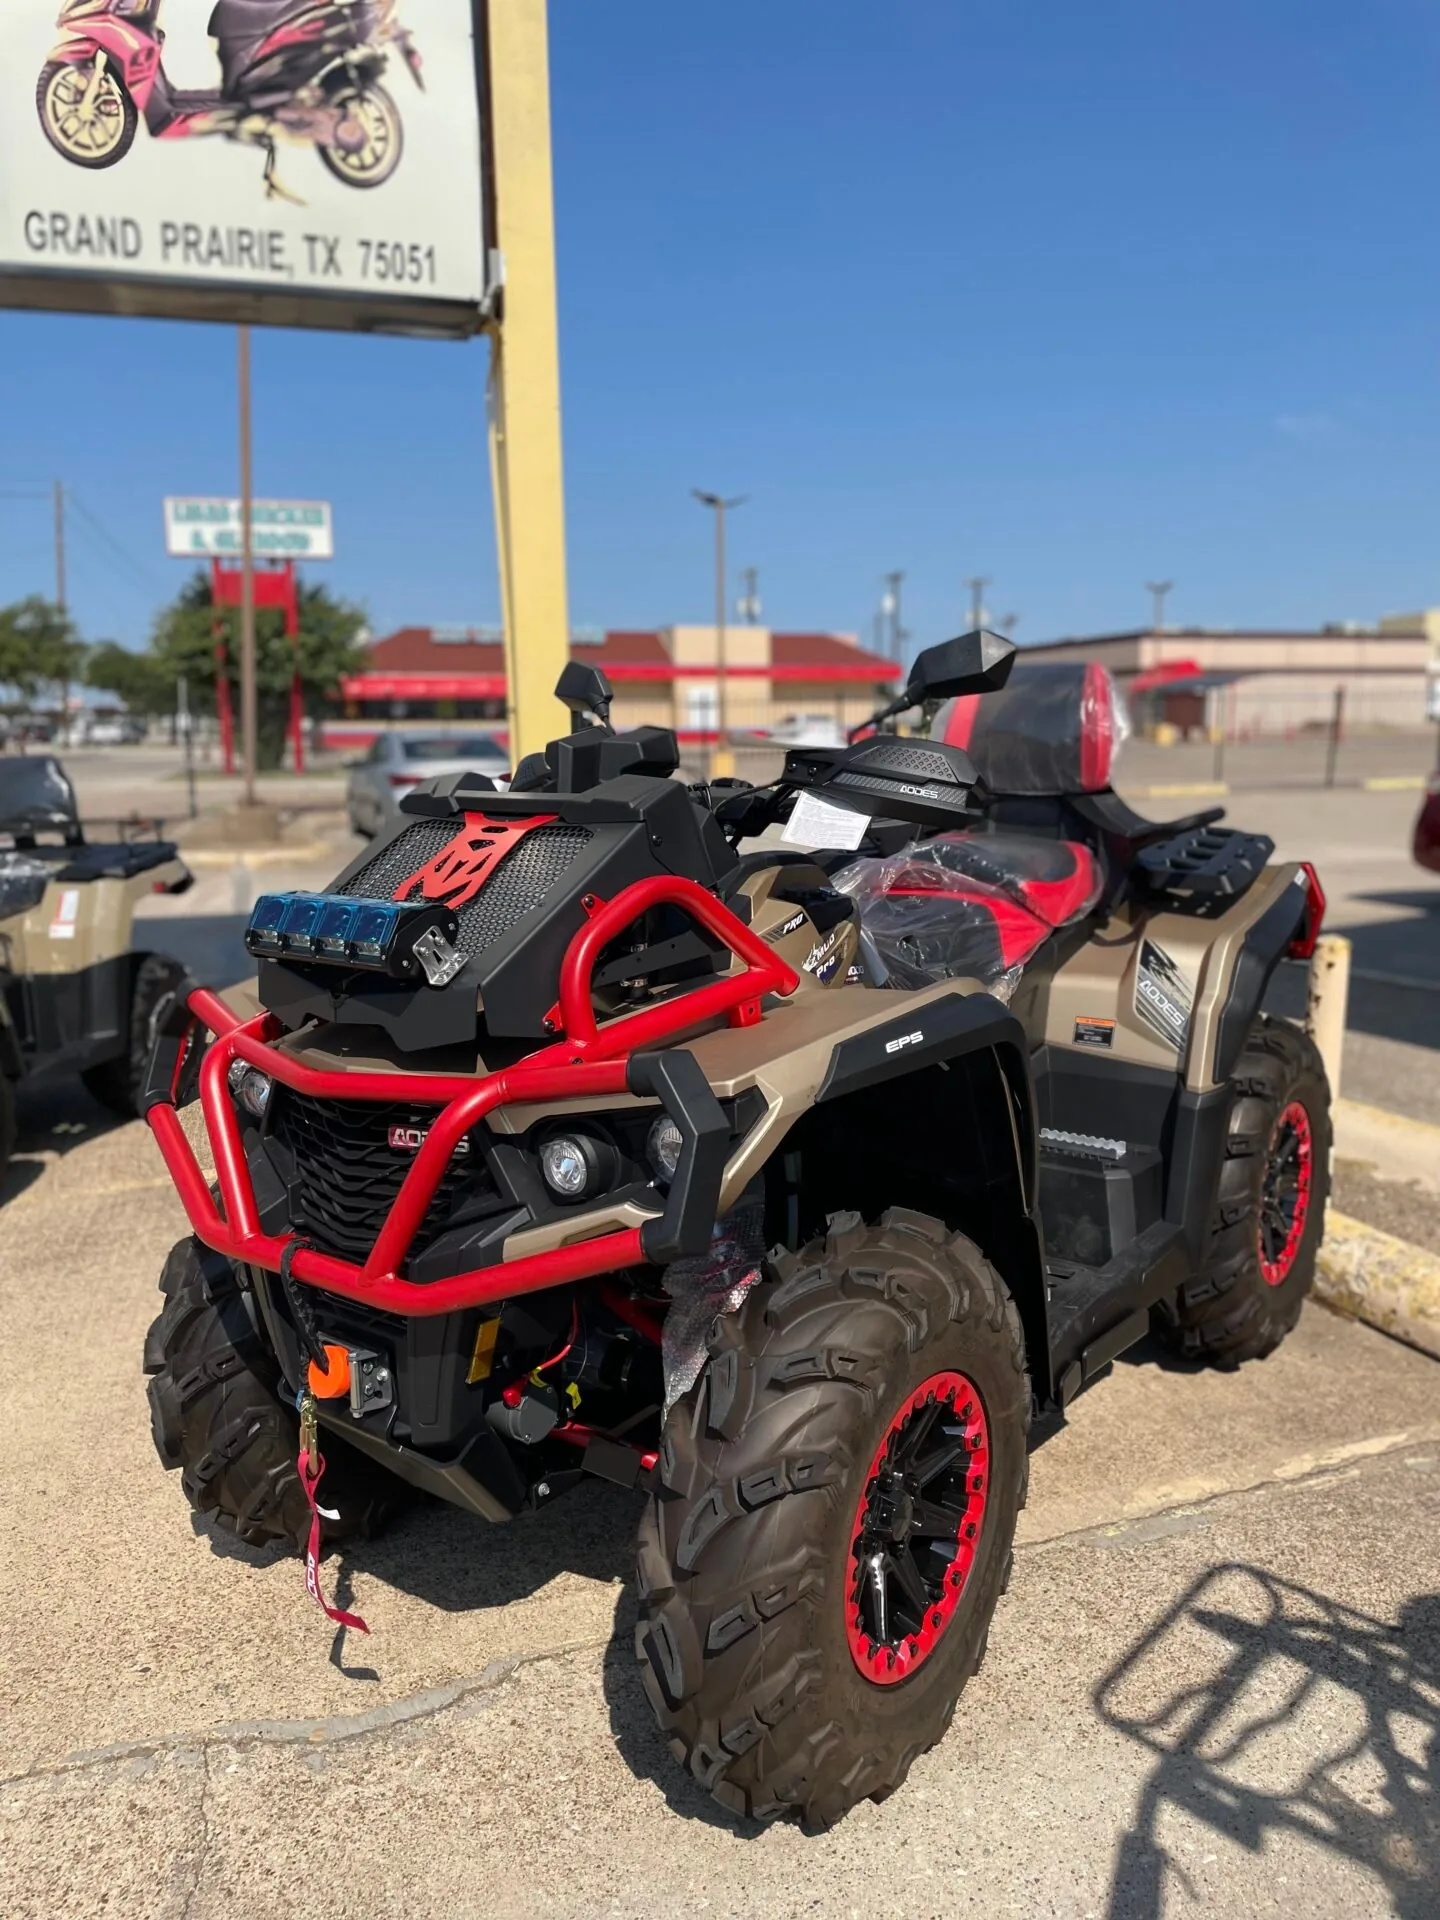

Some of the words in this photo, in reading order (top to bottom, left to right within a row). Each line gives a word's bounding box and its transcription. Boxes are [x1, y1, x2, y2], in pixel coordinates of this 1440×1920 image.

[24, 209, 142, 260] GRAND
[160, 219, 294, 281] PRAIRIE,
[302, 233, 342, 278] TX
[357, 238, 436, 284] 75051
[900, 785, 939, 799] AODES
[782, 913, 804, 934] PRO
[1139, 979, 1186, 1027] AODES
[885, 1030, 924, 1053] EPS
